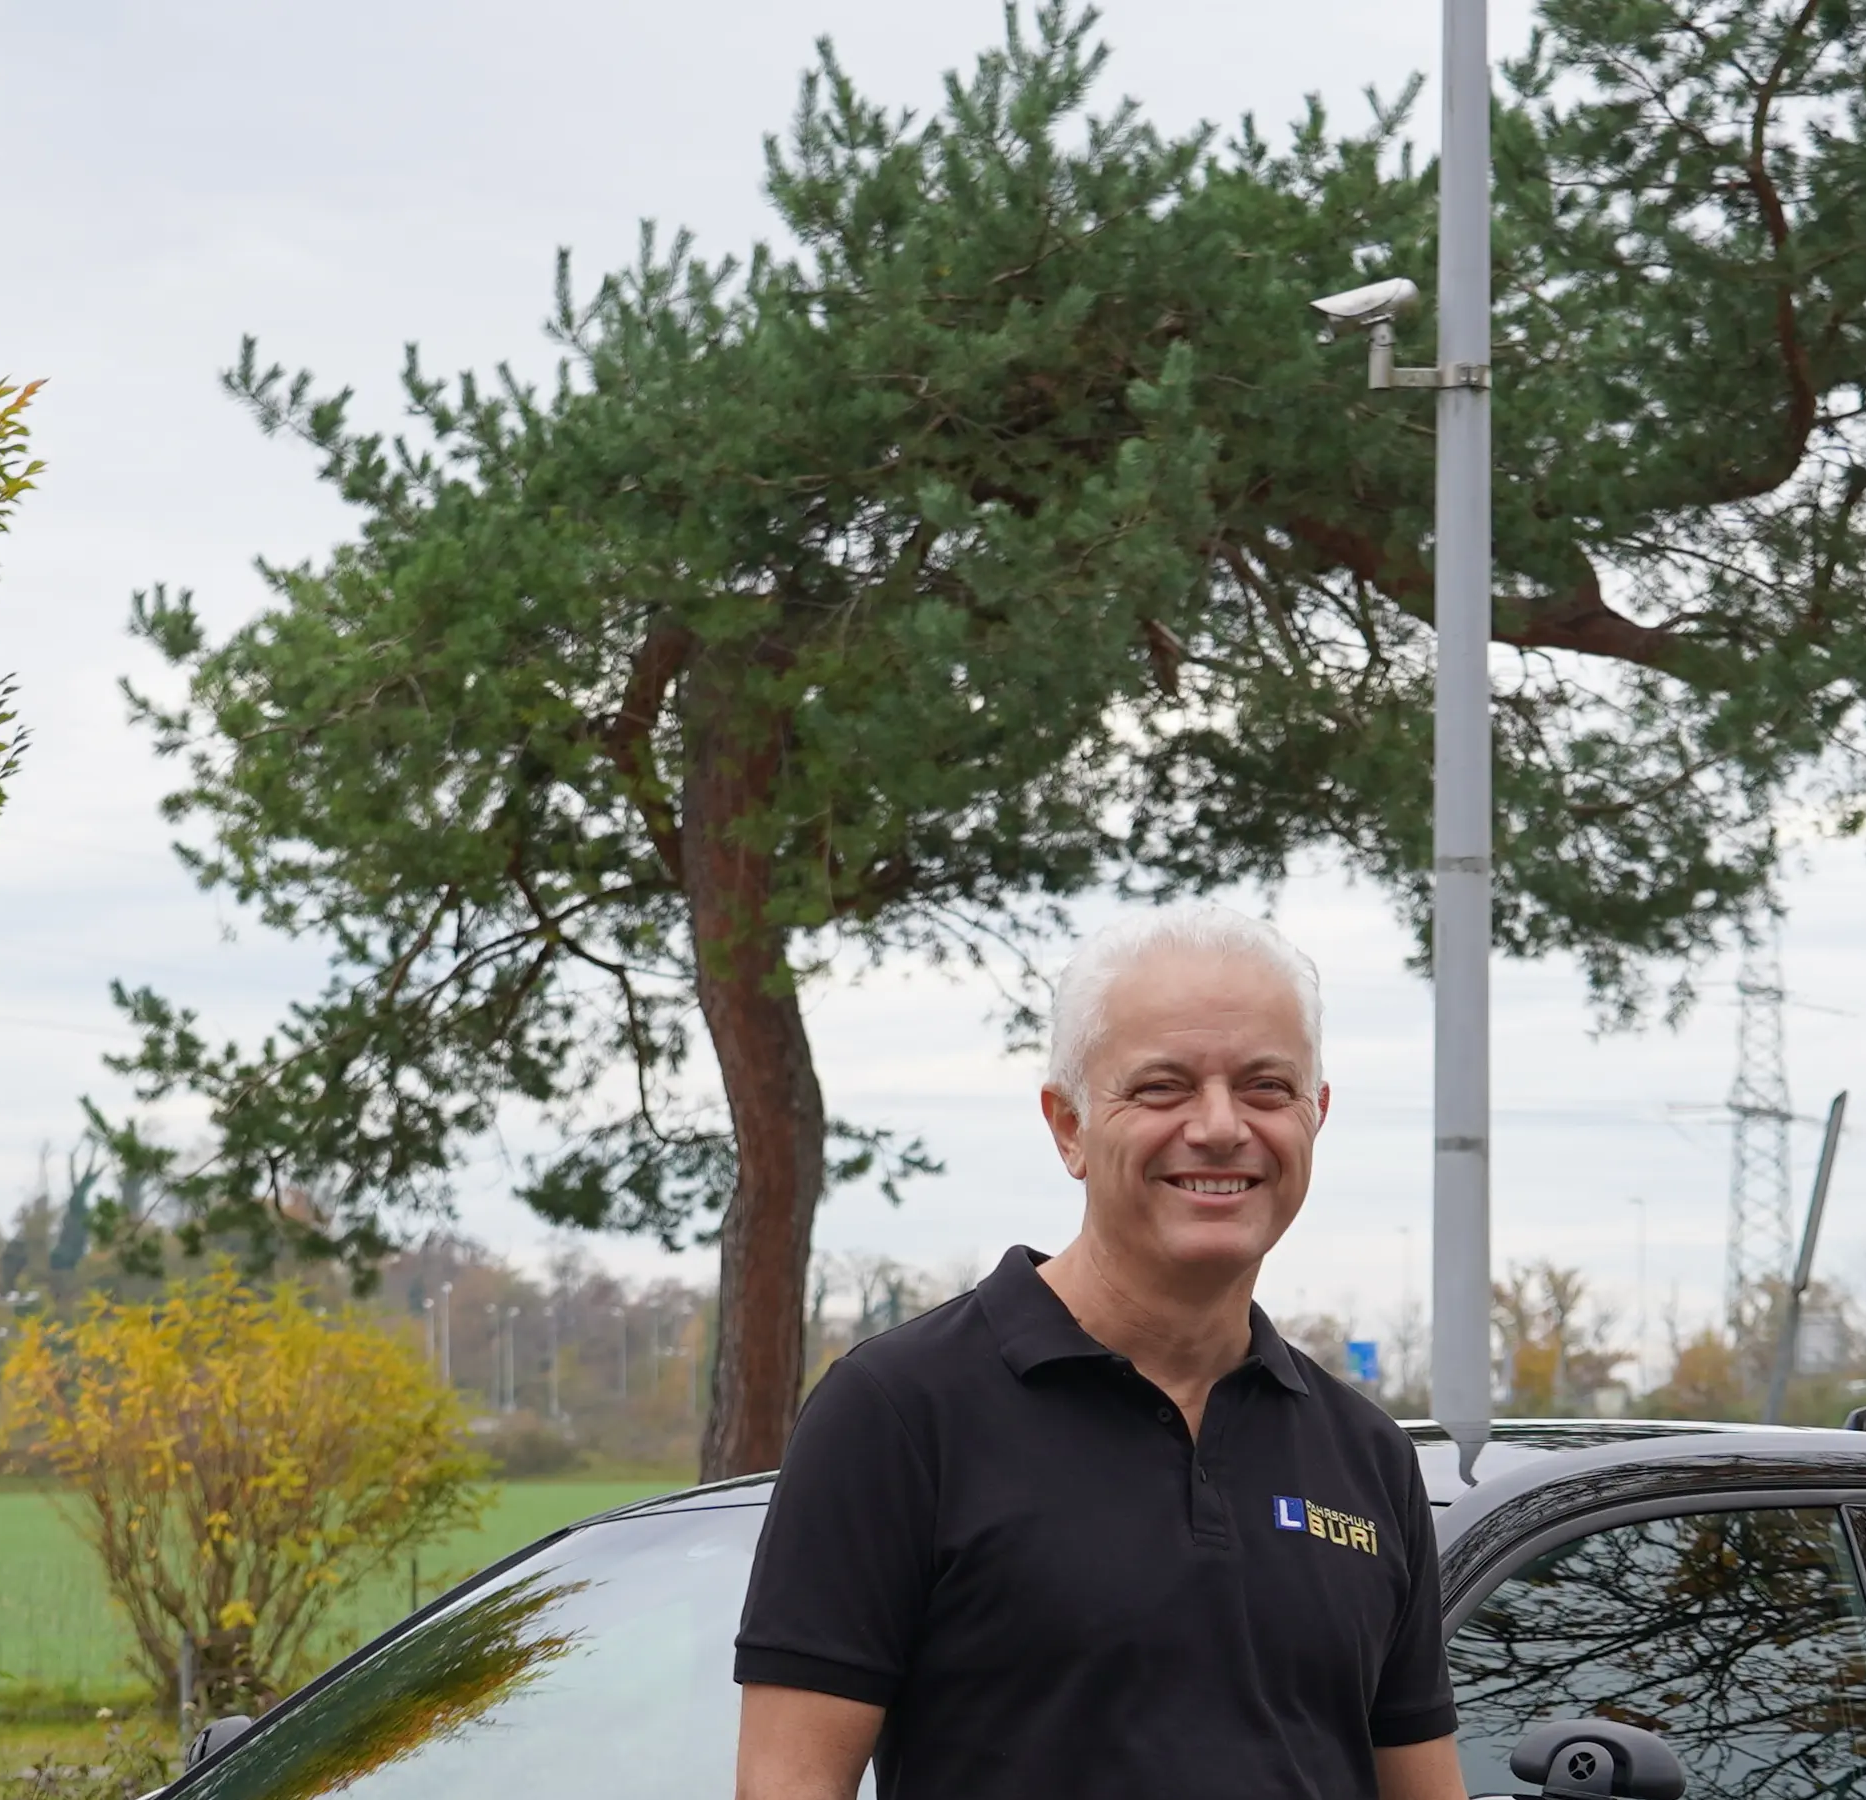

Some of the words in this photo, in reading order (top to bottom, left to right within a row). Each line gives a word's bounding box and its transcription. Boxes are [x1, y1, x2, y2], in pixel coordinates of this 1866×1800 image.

[1279, 1499, 1302, 1528] L
[1305, 1499, 1376, 1532] FAHRSCHULE
[1307, 1512, 1378, 1556] BURI
